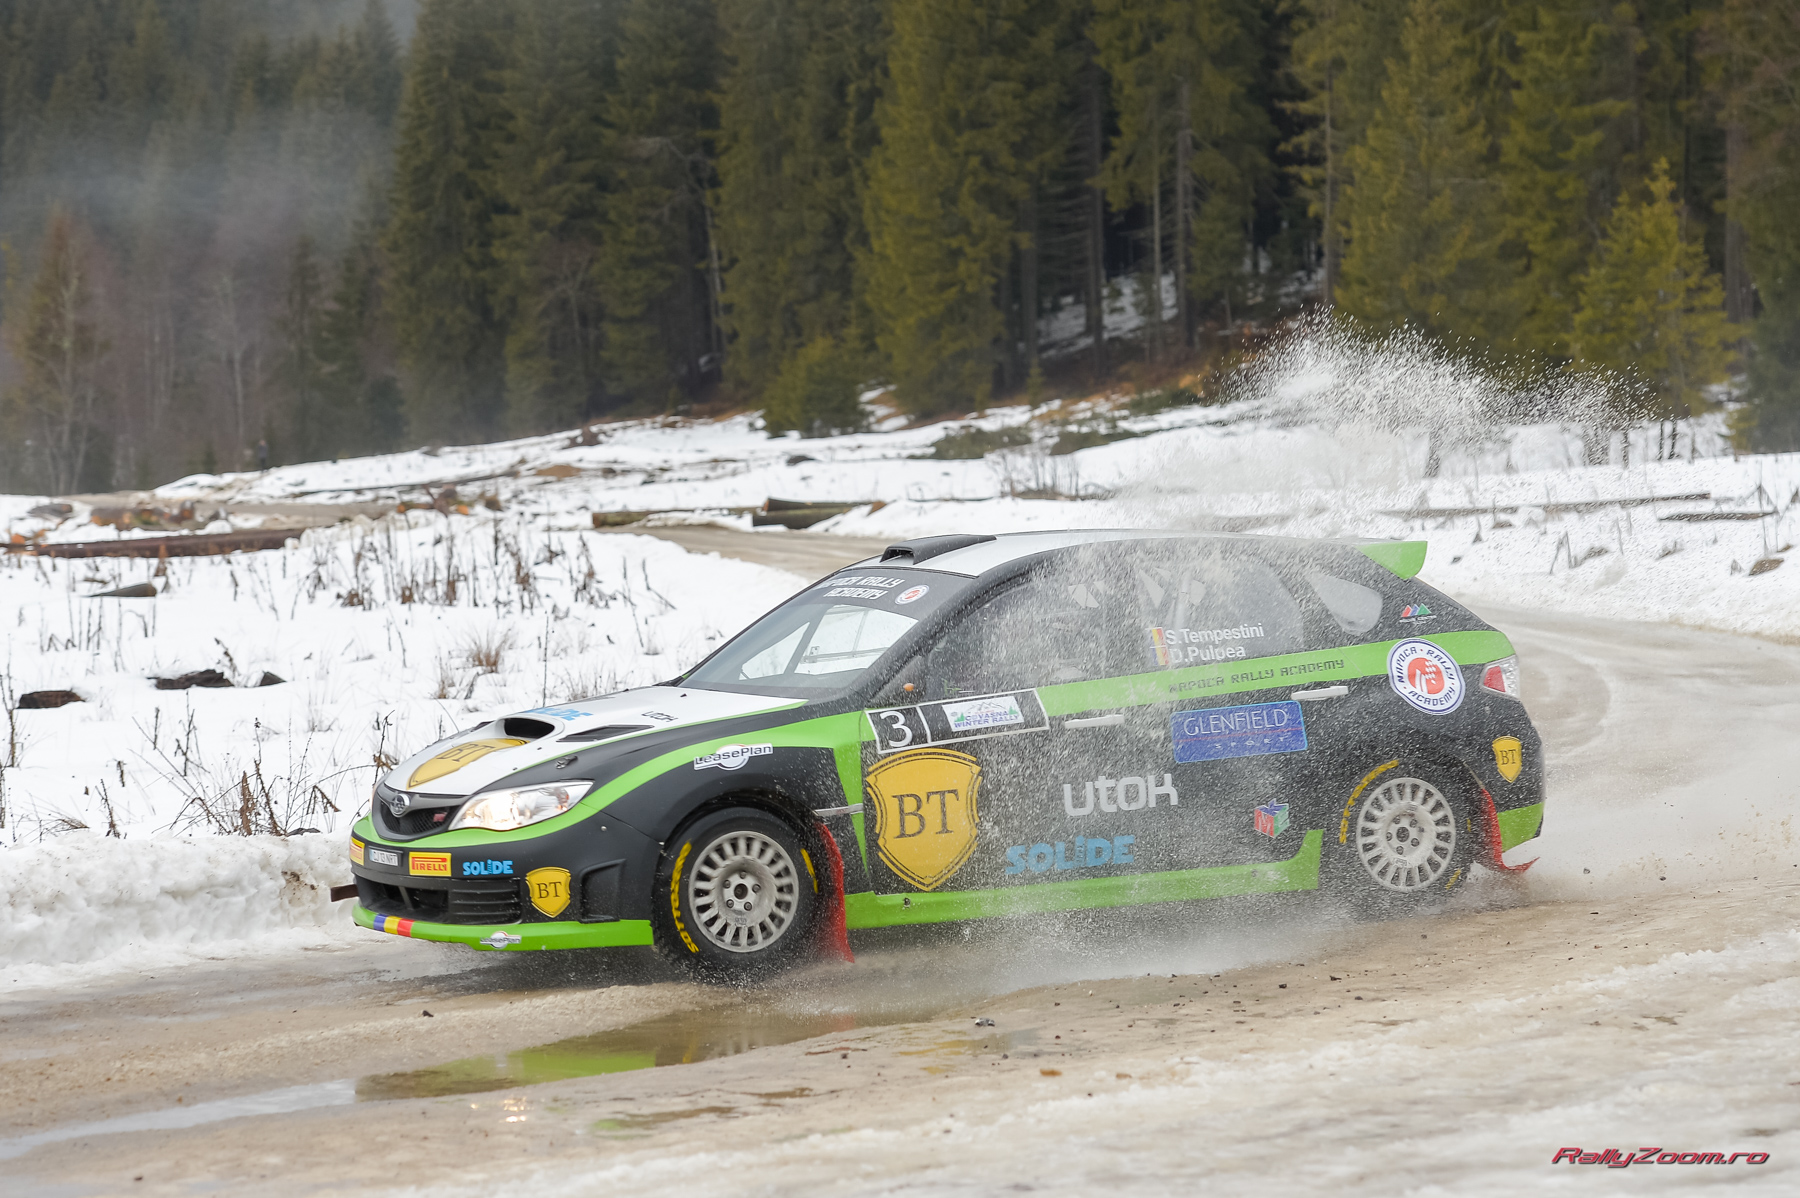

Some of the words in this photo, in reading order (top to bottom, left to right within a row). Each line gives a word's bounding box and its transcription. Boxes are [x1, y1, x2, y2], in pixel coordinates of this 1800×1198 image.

[856, 576, 905, 588] RALLY
[1165, 623, 1264, 645] S.Tempestini
[1396, 646, 1418, 684] NAPOCA
[1426, 649, 1456, 680] RALLY
[1168, 676, 1225, 693] NAPOCA
[1231, 669, 1275, 684] RALLY
[1280, 659, 1346, 677] ACADEMY
[1408, 686, 1456, 707] ACADEMY
[880, 711, 913, 748] 3
[954, 719, 989, 728] WINTER
[992, 714, 1019, 724] RALLY
[1183, 708, 1288, 736] GLENFIELD
[436, 743, 496, 762] BT
[695, 745, 772, 765] LeasePlan
[1499, 749, 1517, 766] BT
[891, 788, 960, 840] BT
[411, 856, 448, 872] PIRELLI
[537, 881, 562, 899] BT
